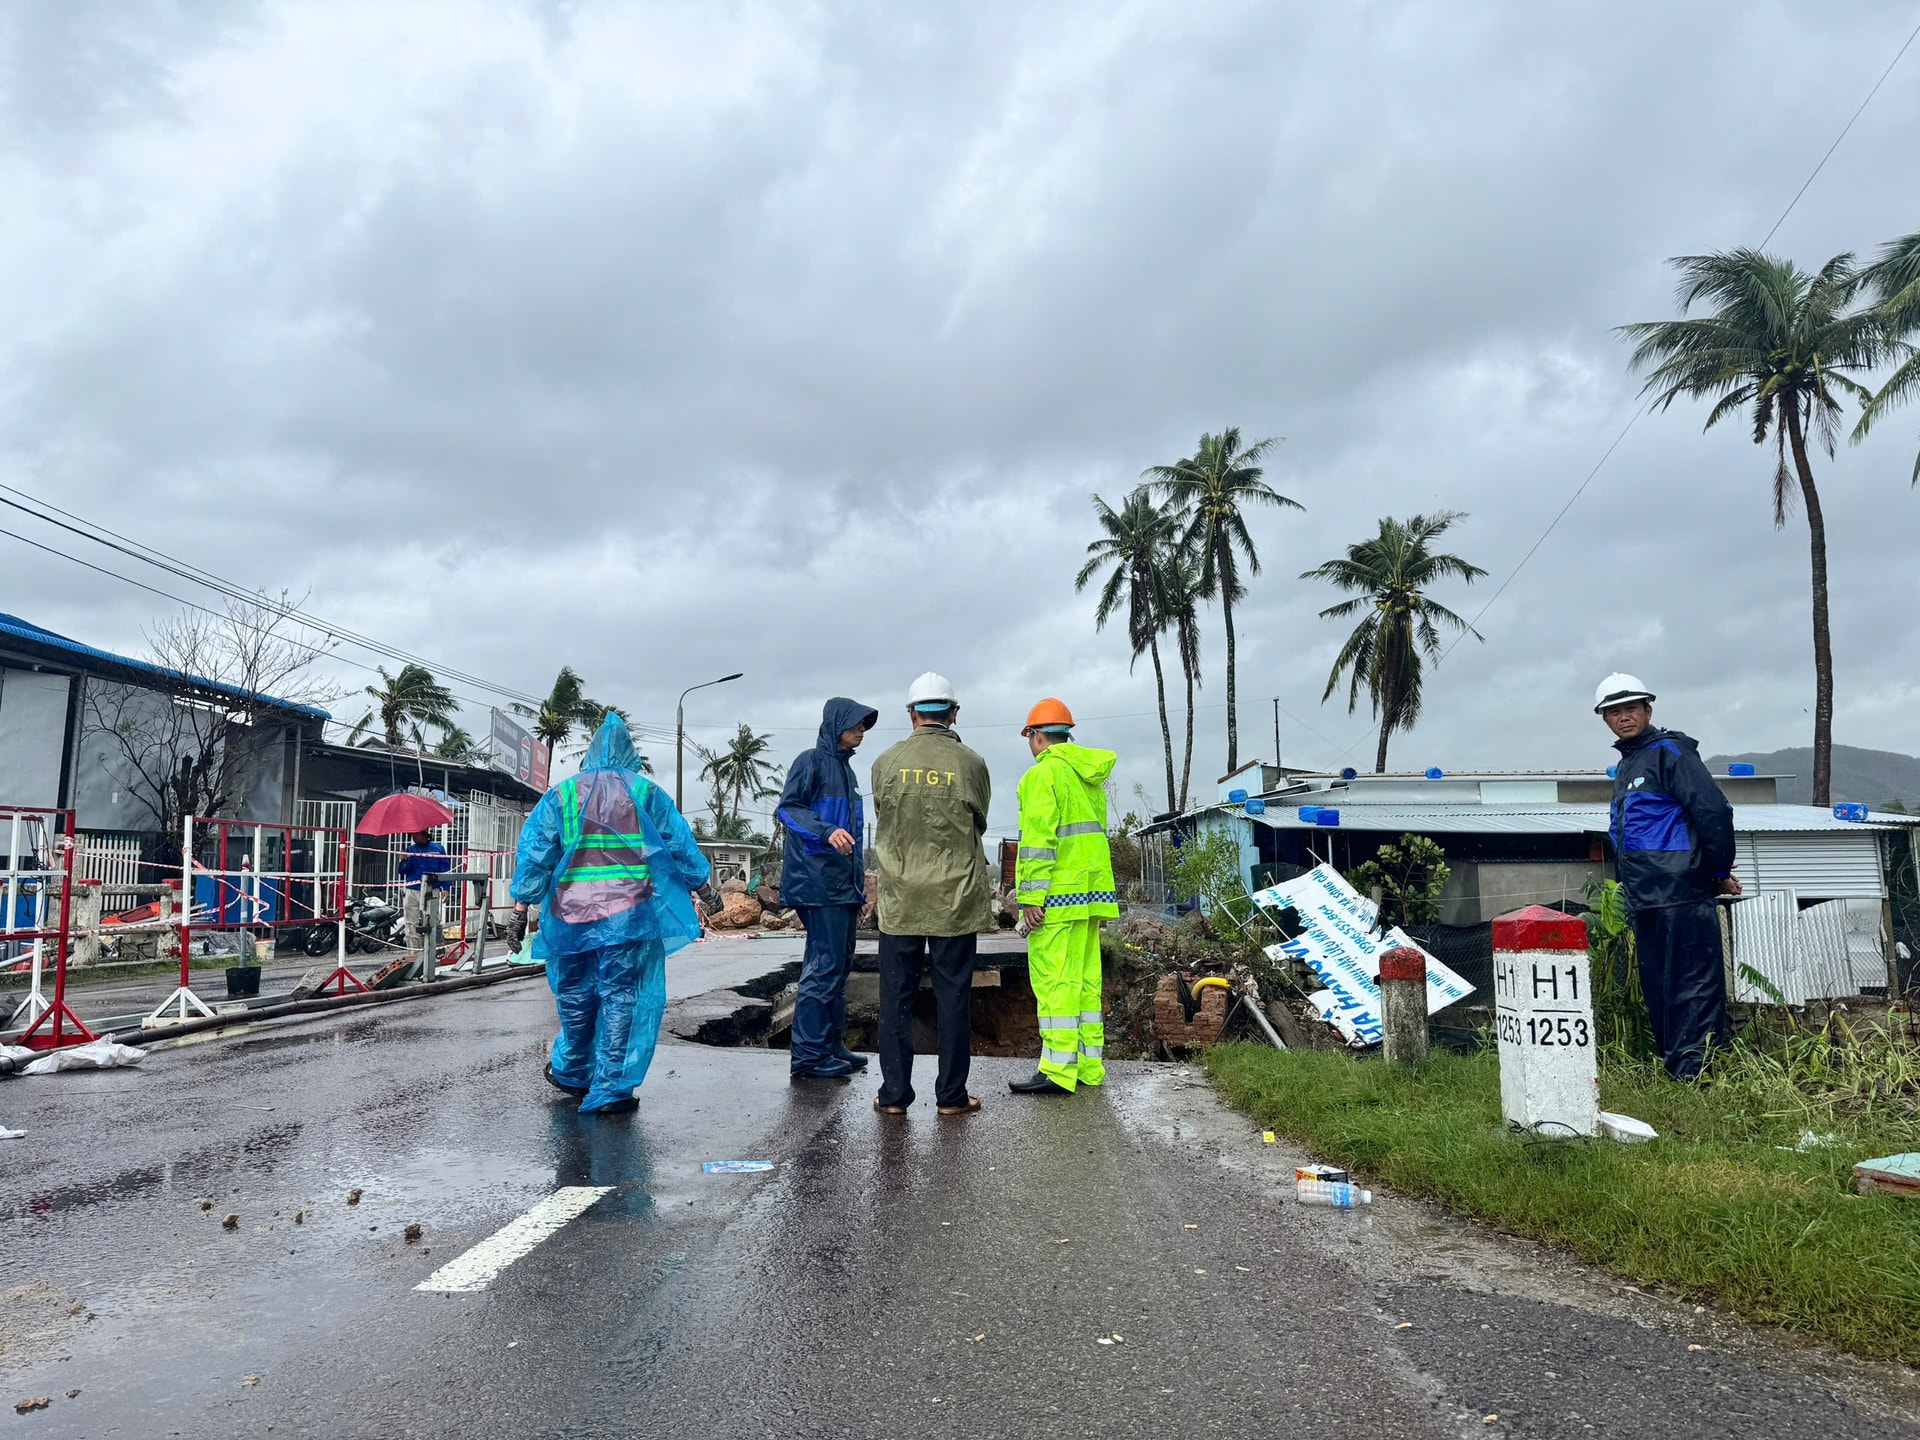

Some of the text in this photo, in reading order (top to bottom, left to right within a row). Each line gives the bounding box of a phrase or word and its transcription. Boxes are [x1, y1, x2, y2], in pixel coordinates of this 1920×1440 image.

[899, 768, 955, 786] TTGT
[1497, 961, 1516, 998] H1
[1532, 964, 1578, 999] H1
[1498, 1015, 1522, 1046] 1253
[1527, 1018, 1588, 1047] 1253
